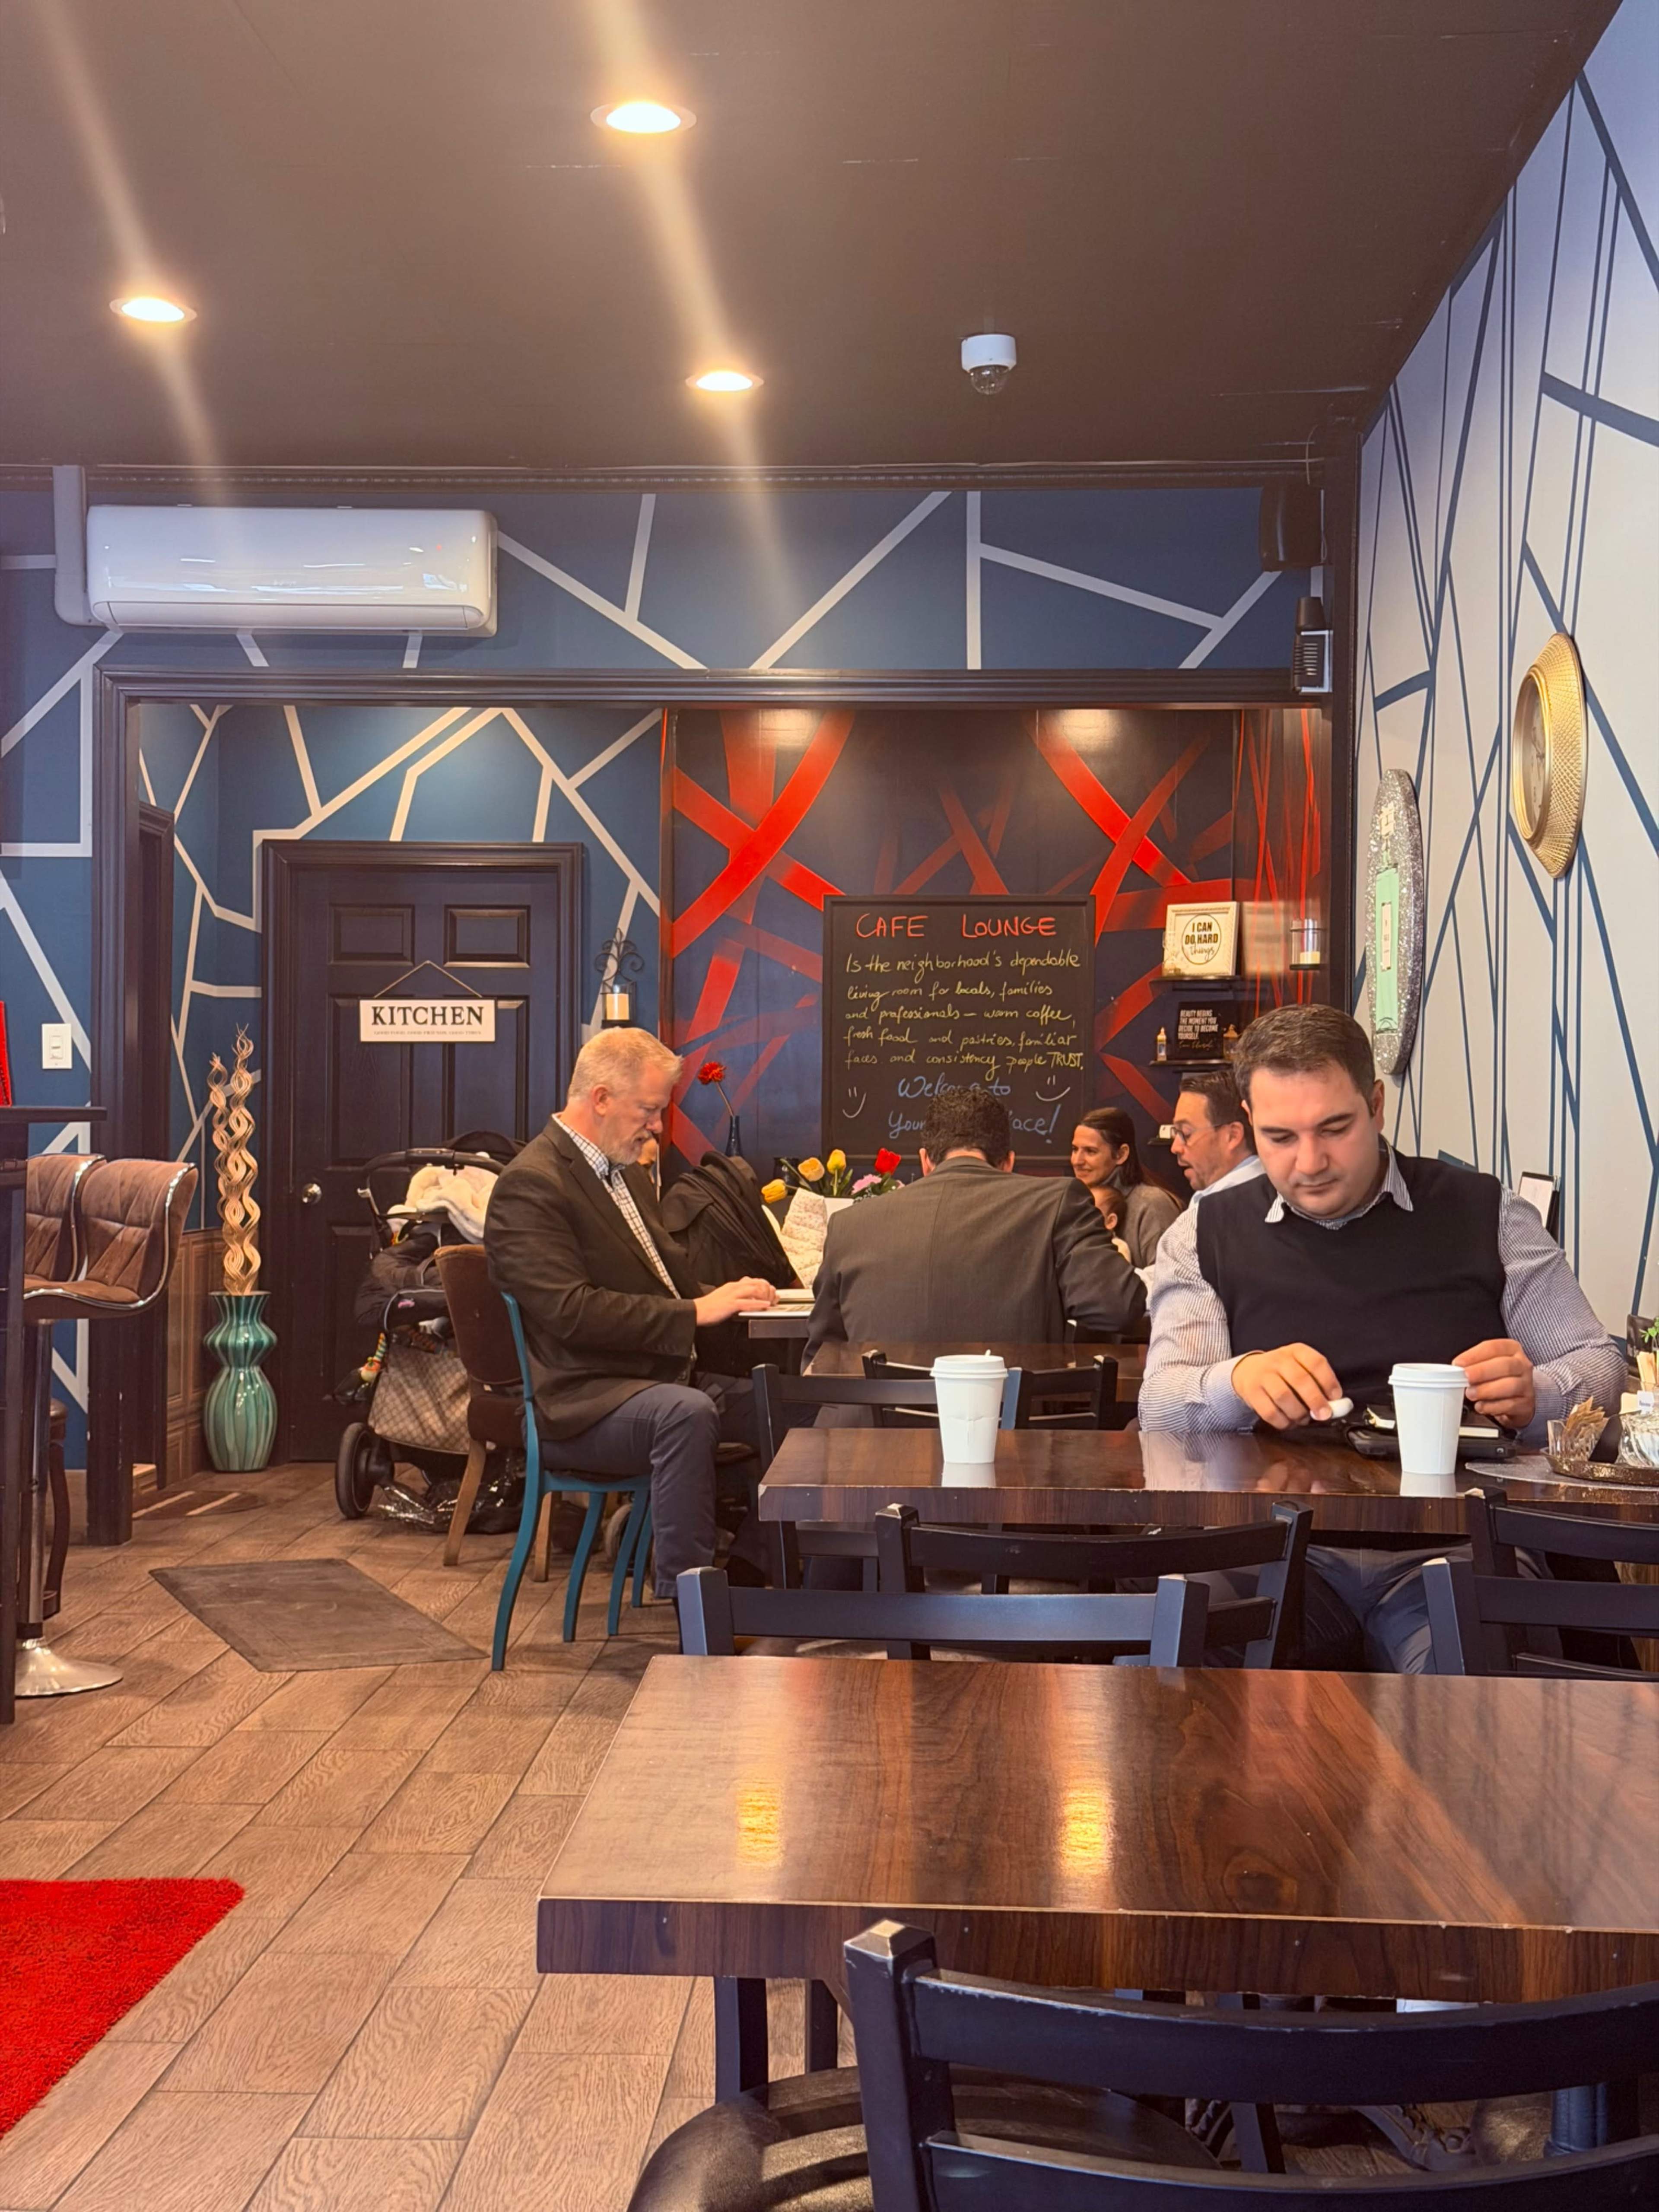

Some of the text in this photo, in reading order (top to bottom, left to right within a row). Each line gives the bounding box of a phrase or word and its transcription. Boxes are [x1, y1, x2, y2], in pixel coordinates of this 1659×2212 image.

[856, 913, 1057, 938] CAFE LOUNGE
[1192, 922, 1212, 932] I CAN
[1185, 933, 1218, 945] DO HARD
[846, 949, 1081, 984] Is the neighborhood's dependable
[847, 980, 1053, 1012] living room for locals, families
[372, 1006, 483, 1025] KITCHEN
[845, 1007, 869, 1019] and
[878, 1003, 960, 1025] professionals
[1026, 1004, 1075, 1028] coffee,
[843, 1025, 1077, 1053] fresh food and pastries, familiar
[845, 1048, 1084, 1081] faces and consistency people TRUST.
[988, 1077, 1011, 1096] to
[888, 1110, 925, 1139] Your
